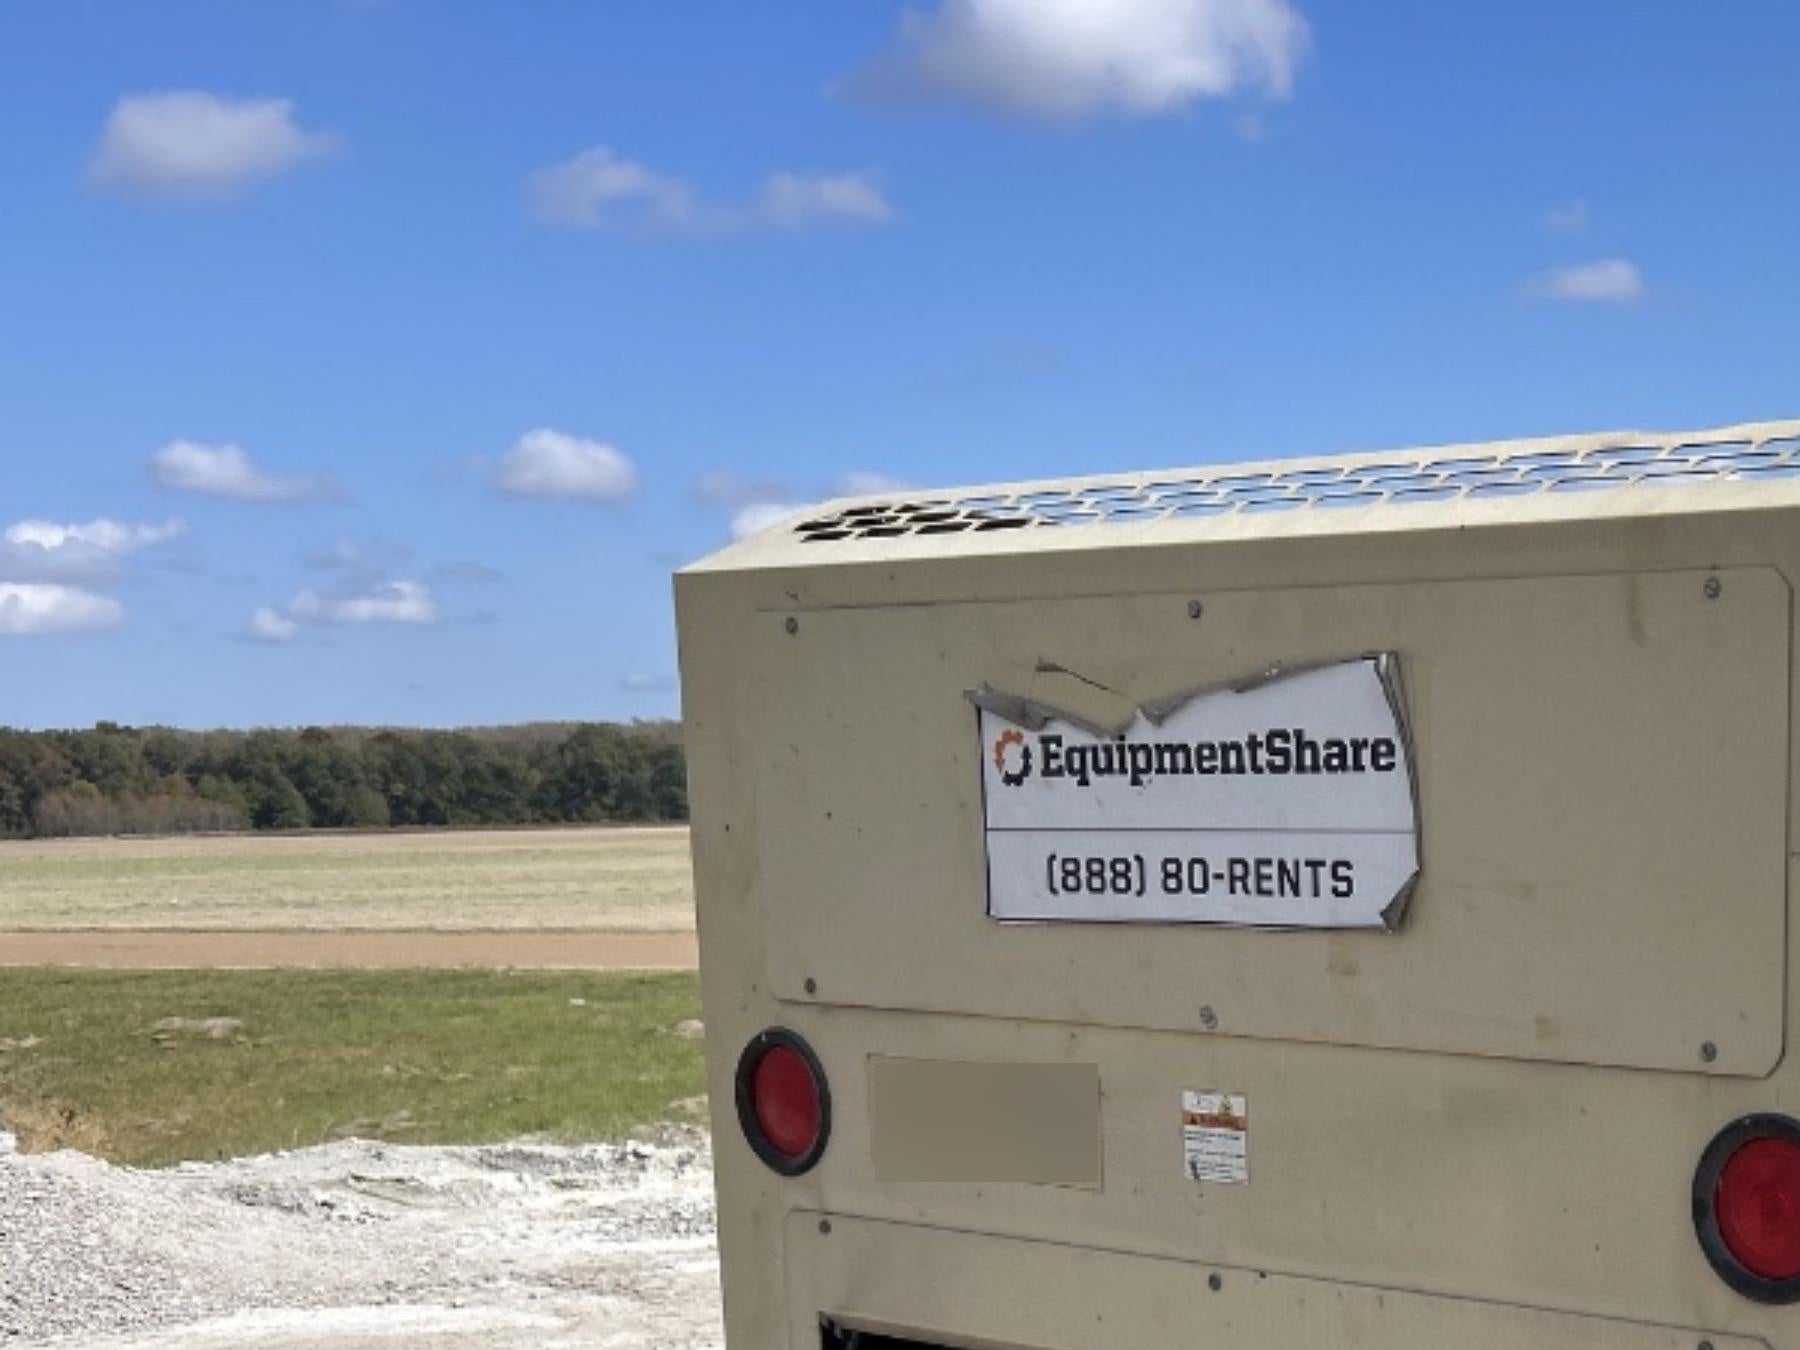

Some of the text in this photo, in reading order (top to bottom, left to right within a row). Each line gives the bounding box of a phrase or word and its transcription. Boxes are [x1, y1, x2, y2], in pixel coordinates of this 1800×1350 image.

[1038, 728, 1397, 788] EquipmentShare
[1046, 853, 1355, 899] (888) 80-RENTS
